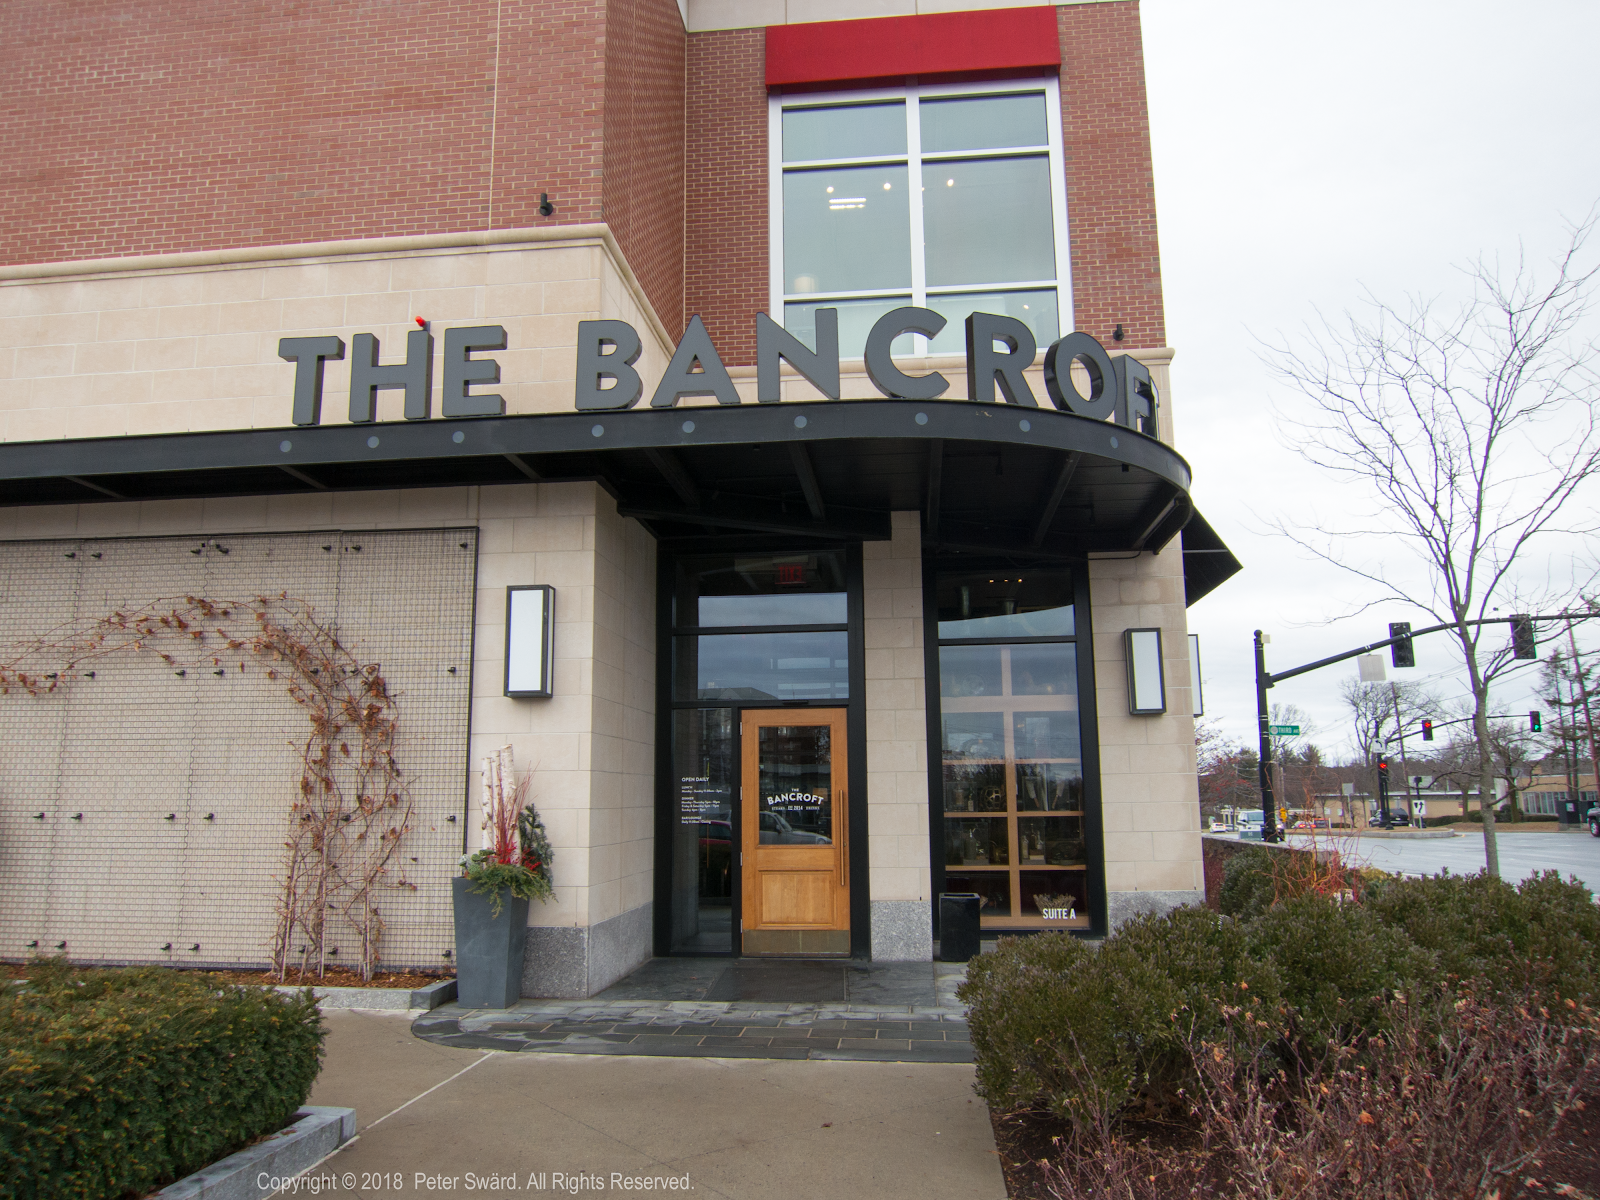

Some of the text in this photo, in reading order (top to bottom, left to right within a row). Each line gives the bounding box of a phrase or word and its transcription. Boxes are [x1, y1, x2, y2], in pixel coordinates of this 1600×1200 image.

[279, 306, 1160, 440] THE BANCROF
[767, 792, 824, 805] BANCROFT
[1042, 908, 1076, 920] SUITE A
